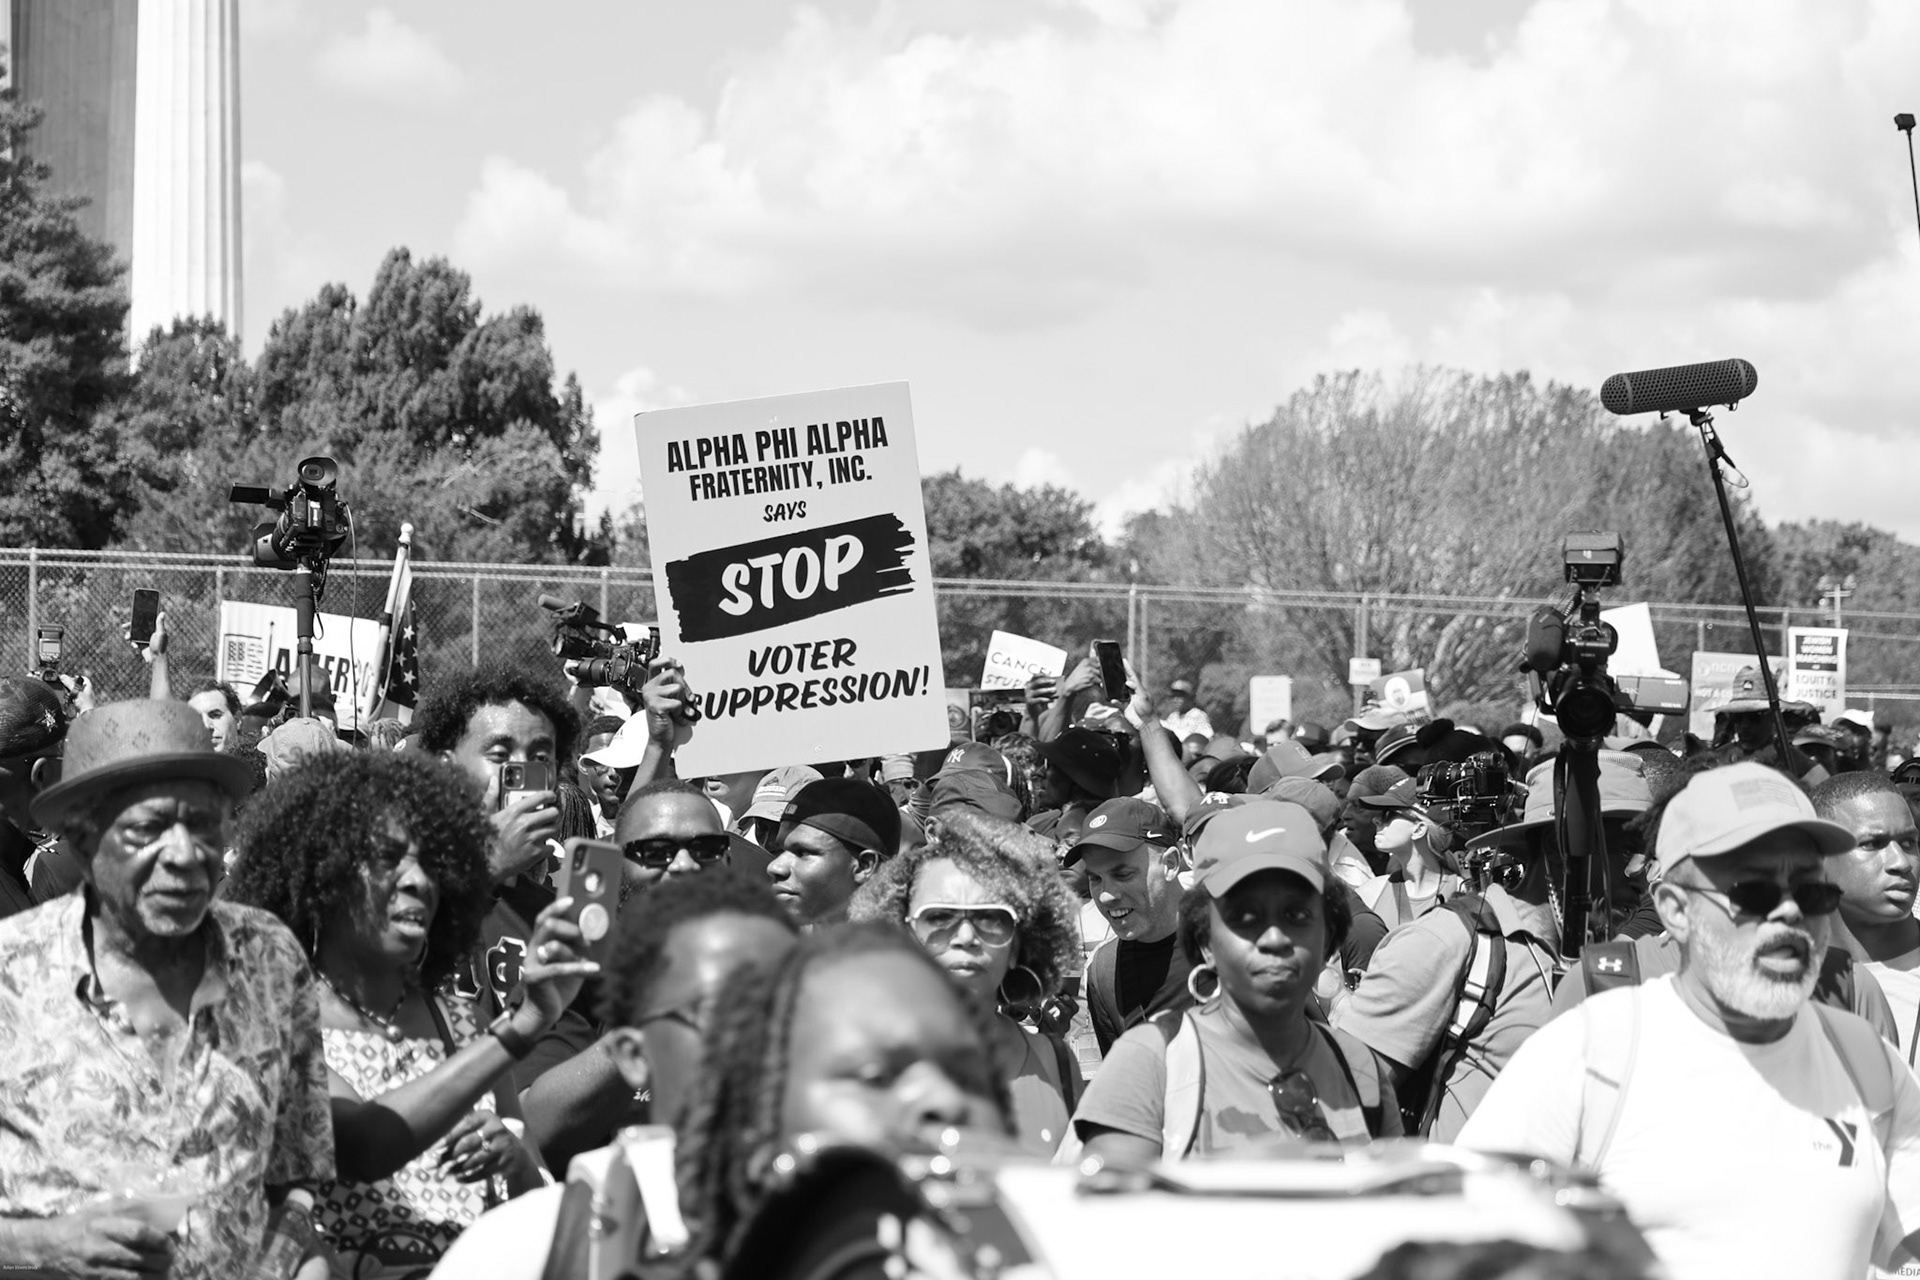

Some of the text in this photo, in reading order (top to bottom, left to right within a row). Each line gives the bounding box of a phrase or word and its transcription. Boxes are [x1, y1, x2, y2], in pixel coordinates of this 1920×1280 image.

[667, 417, 889, 473] ALPHA PHI ALPHA
[690, 455, 873, 502] FRATERNITY, INC.
[763, 500, 807, 523] SAYS
[718, 534, 864, 616] STOP
[748, 638, 857, 678] VOTER
[691, 665, 930, 721] SUPPRESSION!
[1796, 689, 1837, 699] JUSTICE
[1822, 1116, 1857, 1168] Y
